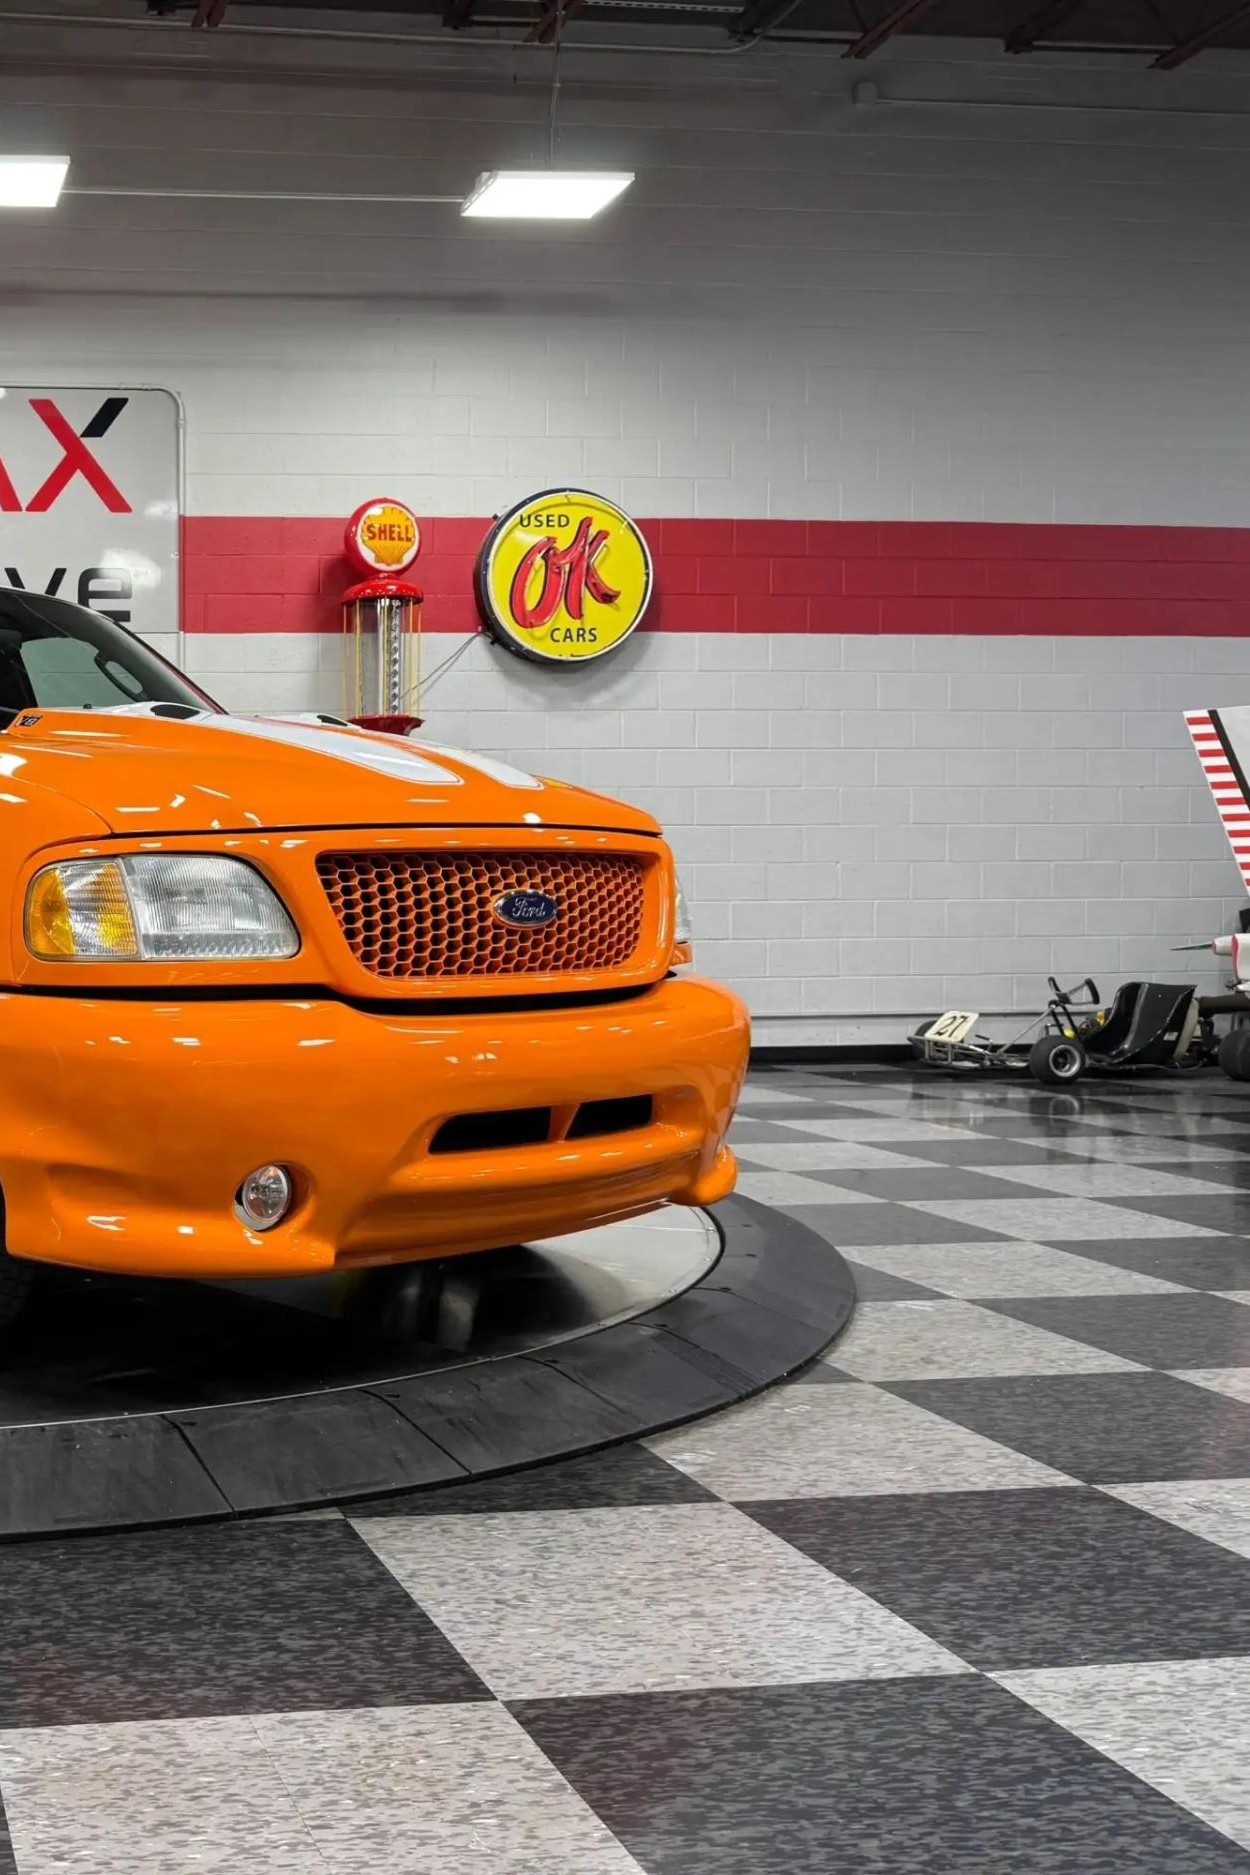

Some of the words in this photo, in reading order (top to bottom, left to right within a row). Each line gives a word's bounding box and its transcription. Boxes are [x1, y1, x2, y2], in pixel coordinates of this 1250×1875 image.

[519, 514, 570, 527] USED
[366, 523, 413, 543] SHELL
[510, 516, 621, 629] OK
[550, 628, 597, 642] CARS
[512, 898, 546, 918] Ford
[934, 1015, 967, 1038] 27
